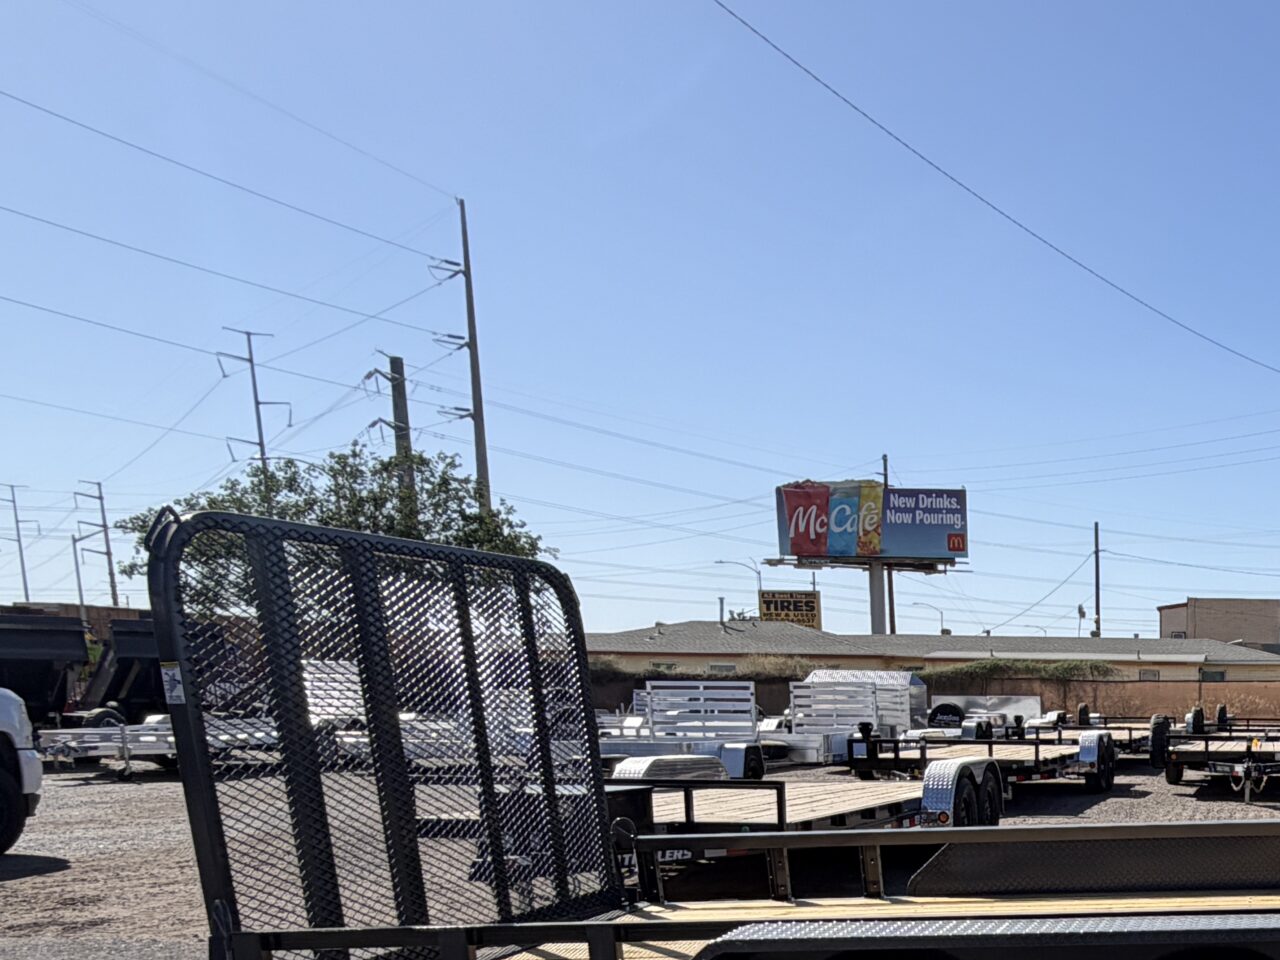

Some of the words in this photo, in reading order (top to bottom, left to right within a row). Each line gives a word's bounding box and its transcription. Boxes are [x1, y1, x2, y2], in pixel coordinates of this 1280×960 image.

[889, 493, 915, 509] New
[918, 494, 961, 509] Drinks.
[789, 502, 880, 539] McCafé
[886, 509, 912, 524] Now
[916, 511, 965, 529] Pouring.
[763, 600, 816, 612] TIRES
